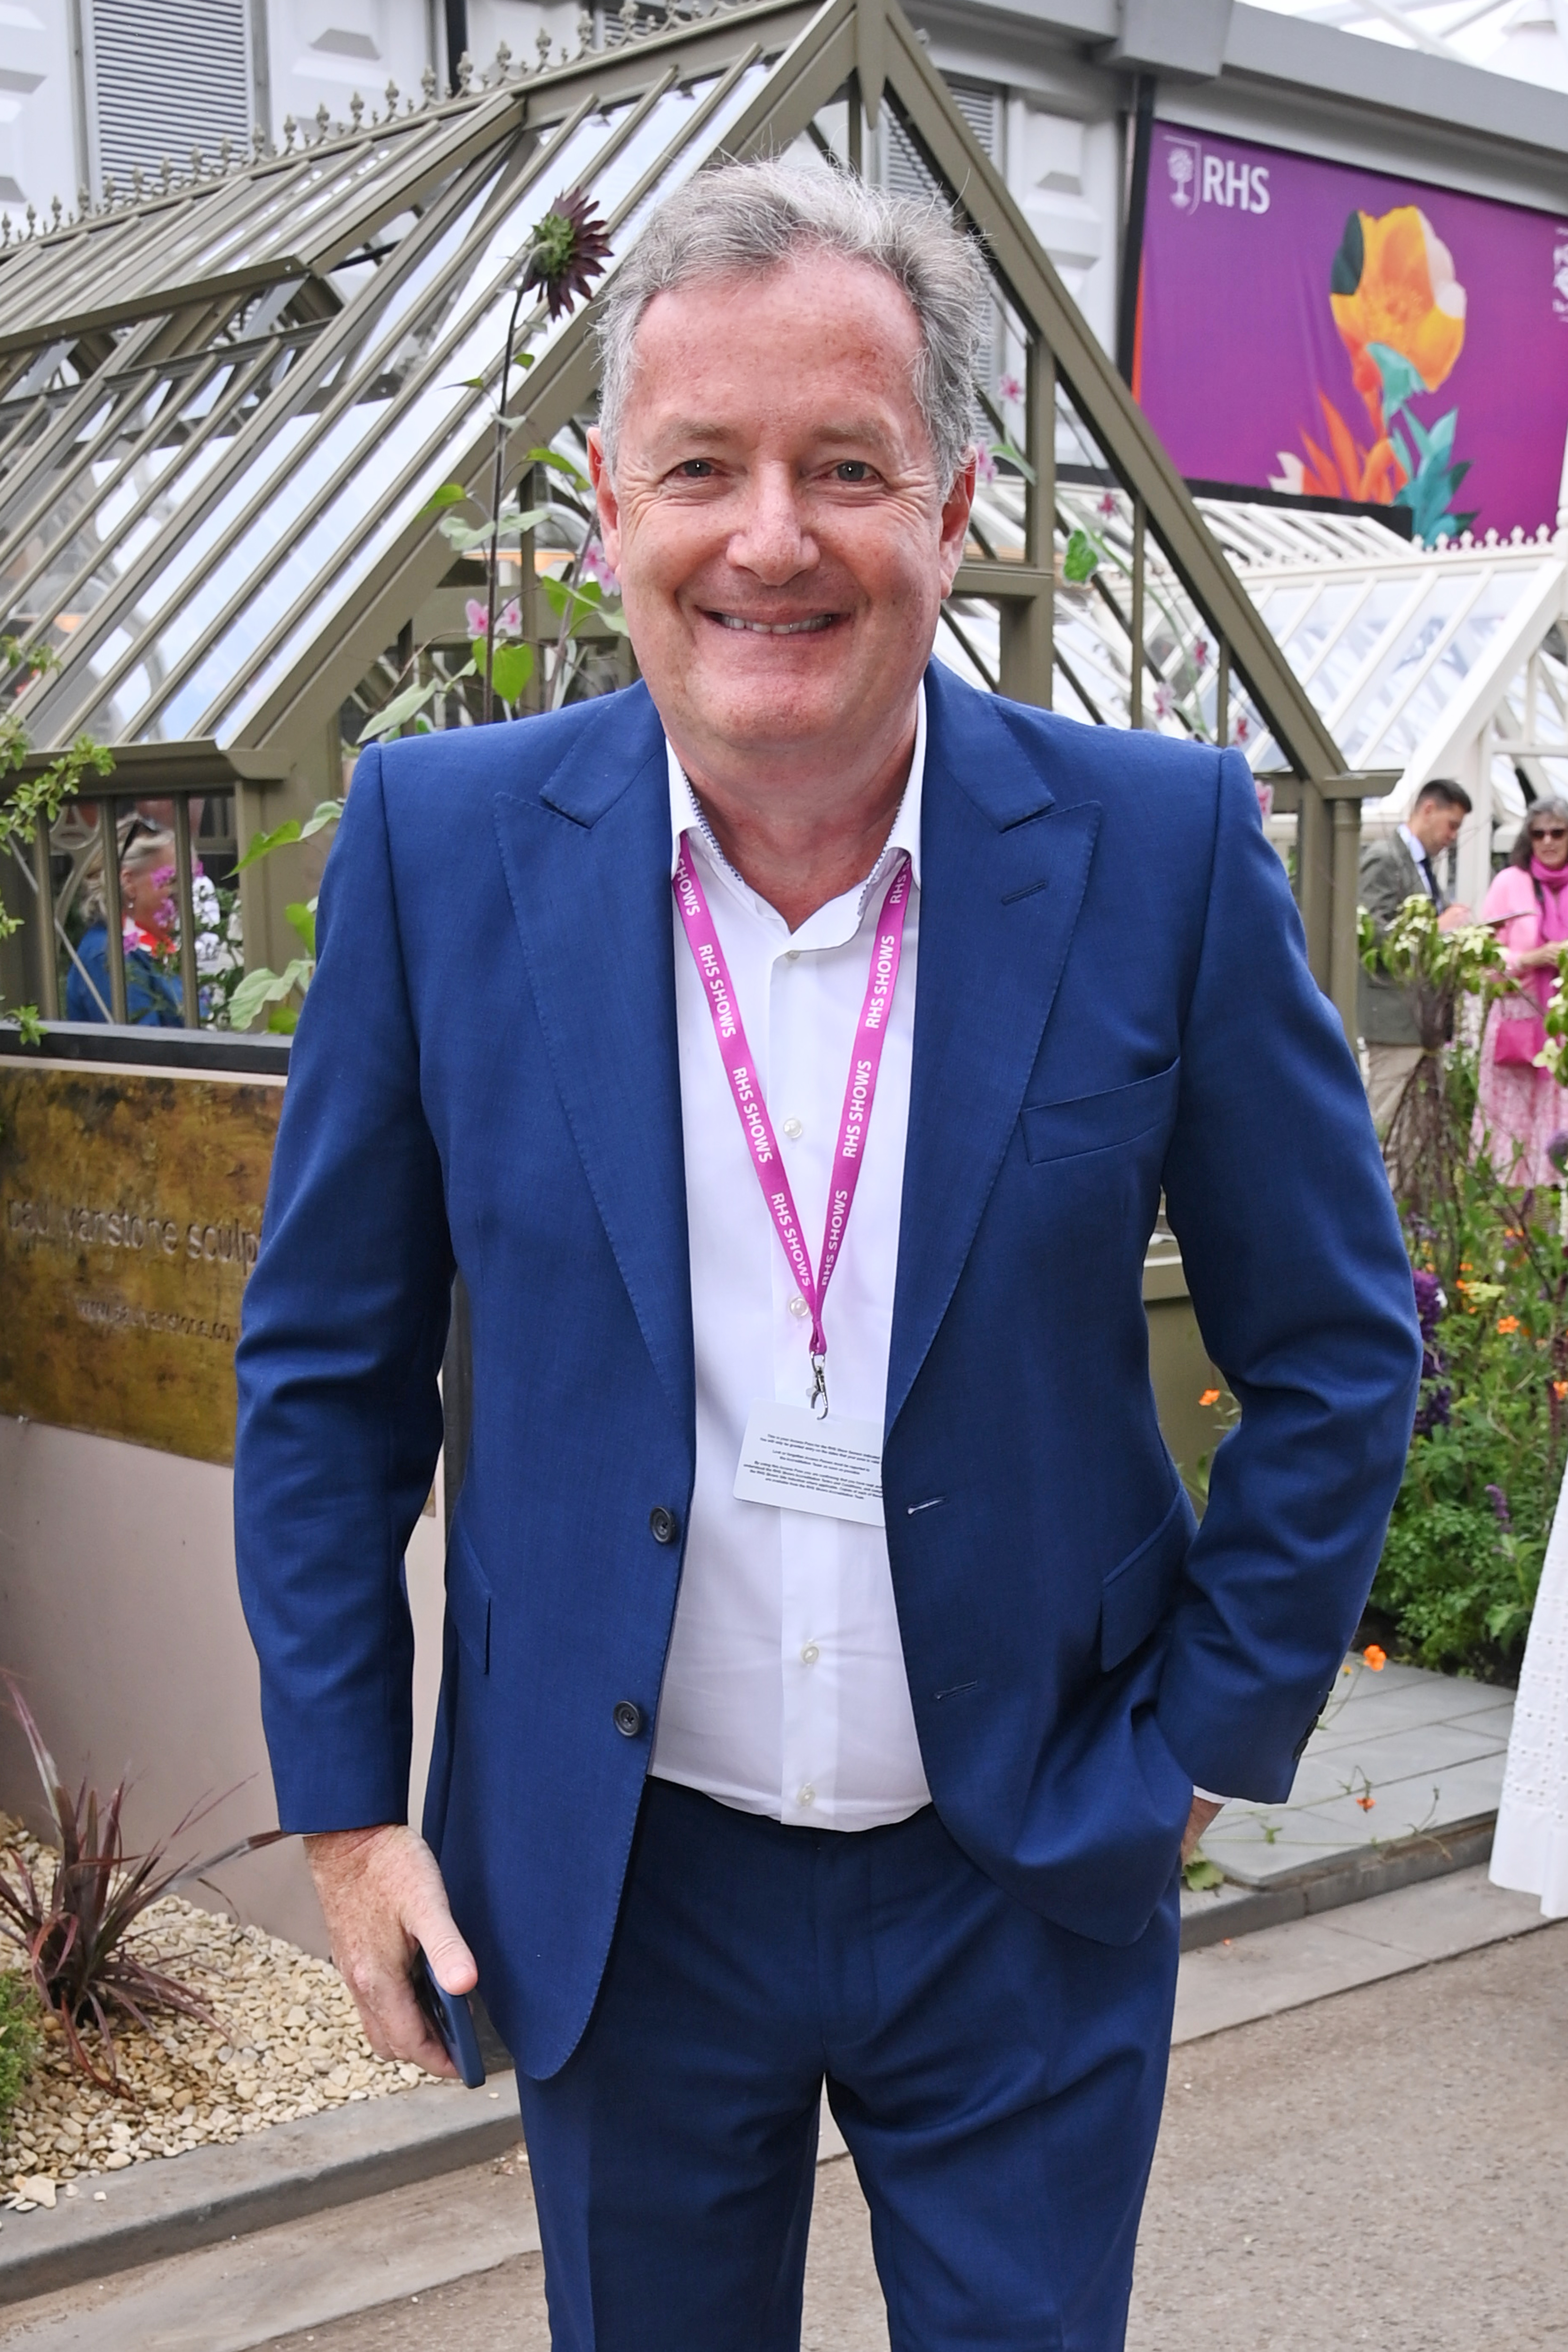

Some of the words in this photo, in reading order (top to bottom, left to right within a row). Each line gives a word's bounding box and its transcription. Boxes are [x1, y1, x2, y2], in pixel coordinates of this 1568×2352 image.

[1202, 156, 1270, 214] RHS
[890, 874, 907, 904] RHS
[698, 944, 720, 977] RHS
[709, 978, 736, 1038] SHOWS
[874, 935, 895, 995] SHOWS
[866, 995, 884, 1029] RHS
[732, 1067, 754, 1101] RHS
[743, 1102, 772, 1163] SHOWS
[849, 1060, 871, 1122] SHOWS
[842, 1123, 860, 1158] RHS
[187, 1217, 262, 1276] sculp
[771, 1192, 792, 1226] RHS
[784, 1227, 811, 1287] SHOWS
[821, 1254, 834, 1286] RHS
[828, 1190, 848, 1250] SHOWS
